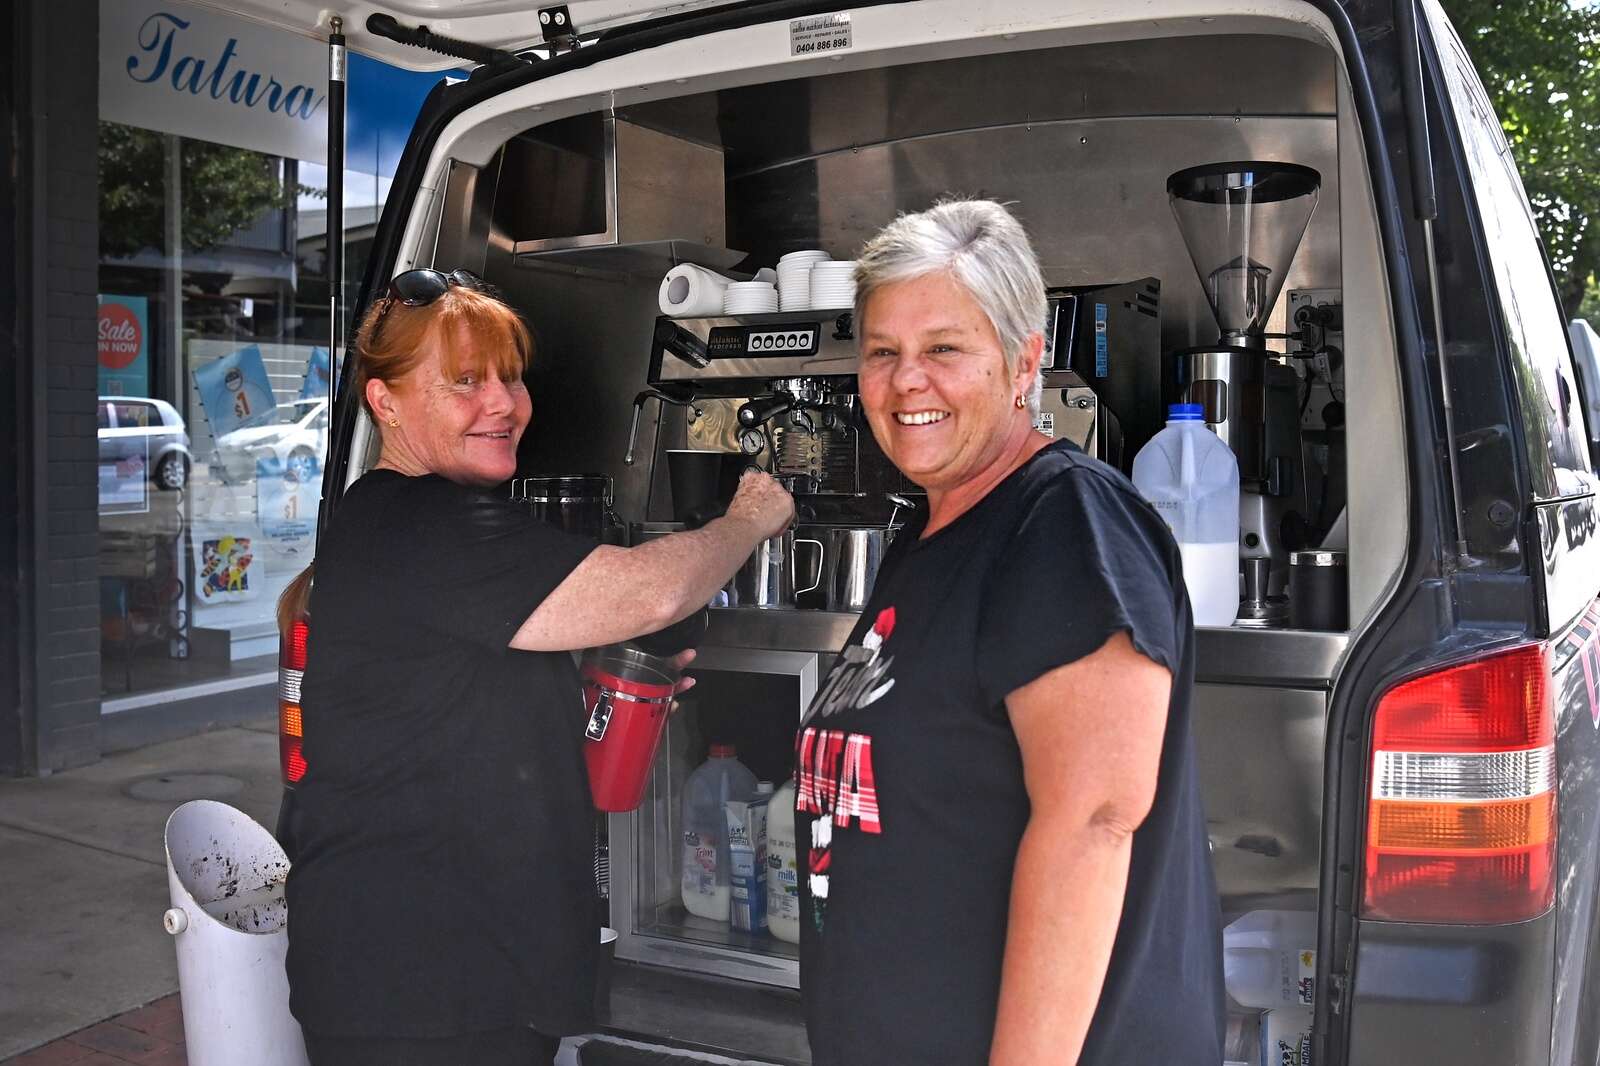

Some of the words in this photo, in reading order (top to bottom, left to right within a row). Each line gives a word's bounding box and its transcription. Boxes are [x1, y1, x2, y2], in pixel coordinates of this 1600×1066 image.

[796, 42, 815, 53] 0404
[816, 40, 831, 50] 886
[832, 37, 847, 48] 896
[126, 12, 326, 121] Tatura
[98, 317, 136, 341] Sale
[111, 341, 138, 353] NOW
[778, 870, 796, 881] milk
